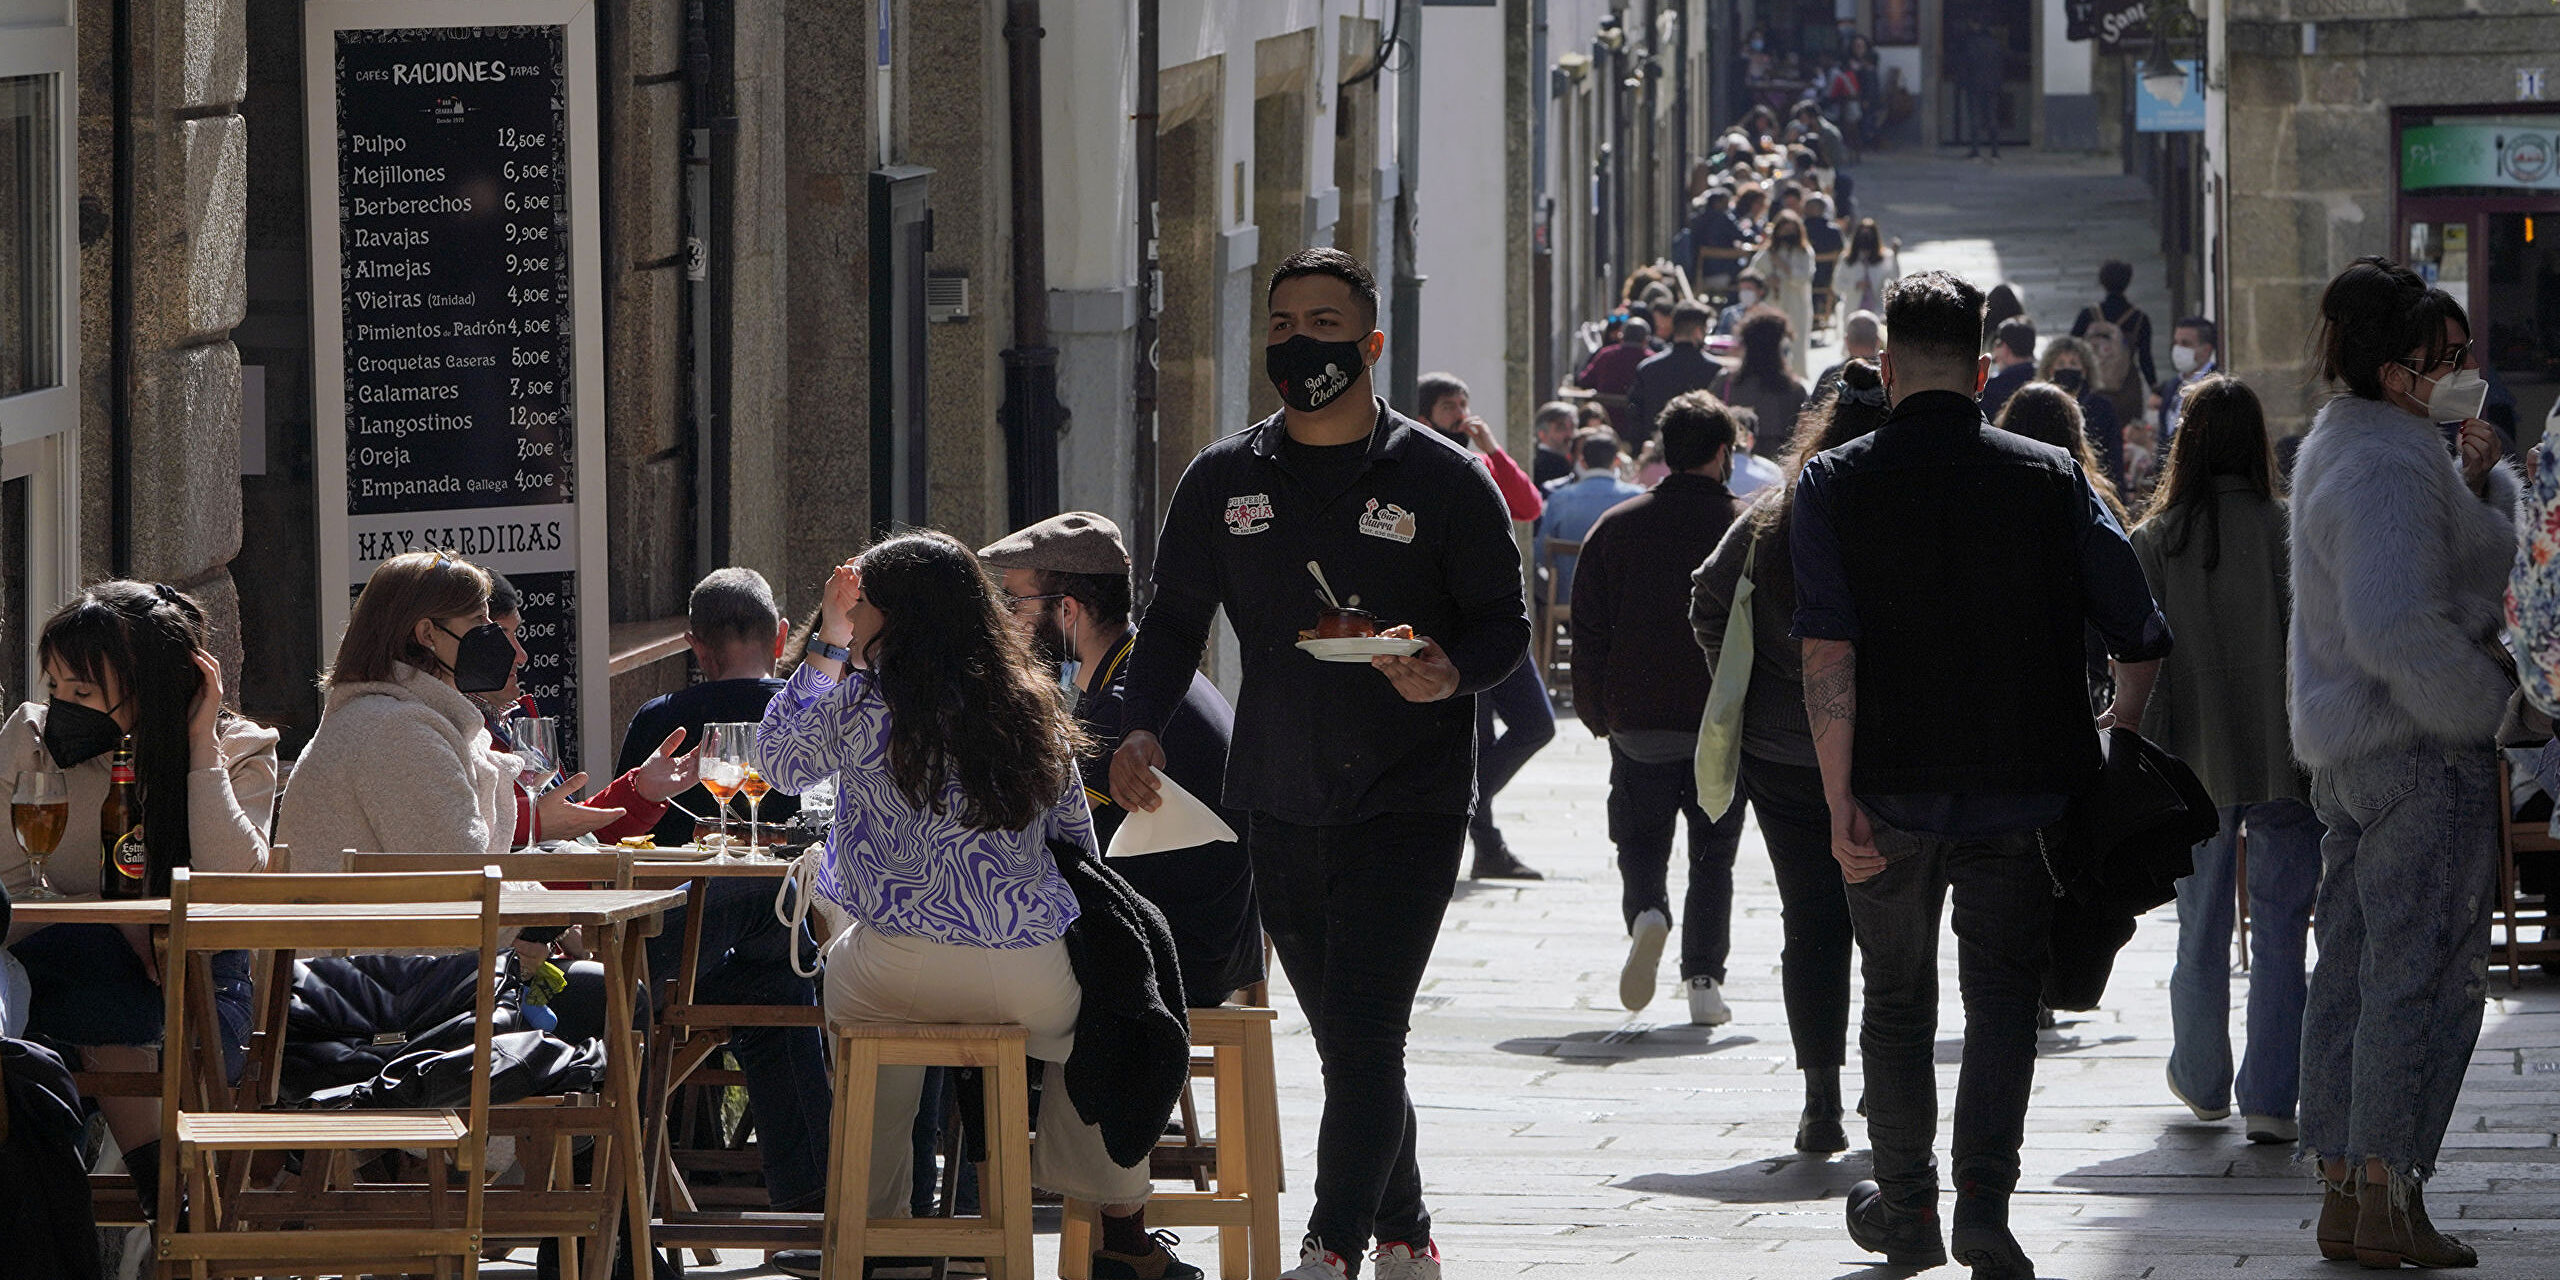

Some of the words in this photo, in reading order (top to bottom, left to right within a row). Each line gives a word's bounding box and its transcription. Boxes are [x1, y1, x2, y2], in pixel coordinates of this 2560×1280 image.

[357, 70, 388, 82] CAFÉS
[393, 61, 506, 86] RACIONES
[510, 65, 540, 77] TAPAS
[353, 134, 406, 155] Pulpo
[499, 128, 545, 151] 12,50€
[353, 166, 446, 188] Mejillones
[355, 195, 472, 216] Berberechos
[355, 228, 429, 250] Navajas
[506, 224, 548, 245] 9,90€
[356, 259, 431, 280] Almejas
[507, 254, 549, 275] 9,90€
[356, 292, 421, 309] Vieiras
[428, 292, 475, 309] (Unidad)
[508, 286, 549, 304] 4,80€
[357, 324, 441, 341] Pimientos
[443, 329, 451, 337] de
[454, 320, 506, 337] Padrón
[358, 354, 441, 375] Croquetas
[446, 354, 496, 368] Caseras
[512, 347, 550, 367] 5,00€
[359, 384, 459, 403] Calamares
[1305, 374, 1327, 393] Bar
[1311, 377, 1349, 406] Charra
[360, 414, 472, 437] Langostinos
[510, 407, 557, 428] 12,00€
[360, 448, 410, 468] Oreja
[517, 439, 554, 461] 7,00€
[362, 476, 460, 500] Empanada
[467, 479, 508, 495] Gallega
[515, 470, 554, 491] 4,00€
[1361, 514, 1393, 531] Charra
[1380, 510, 1398, 521] Bar
[359, 530, 414, 561] HAY
[425, 522, 561, 554] SARDINAS
[517, 654, 560, 672] ,50€
